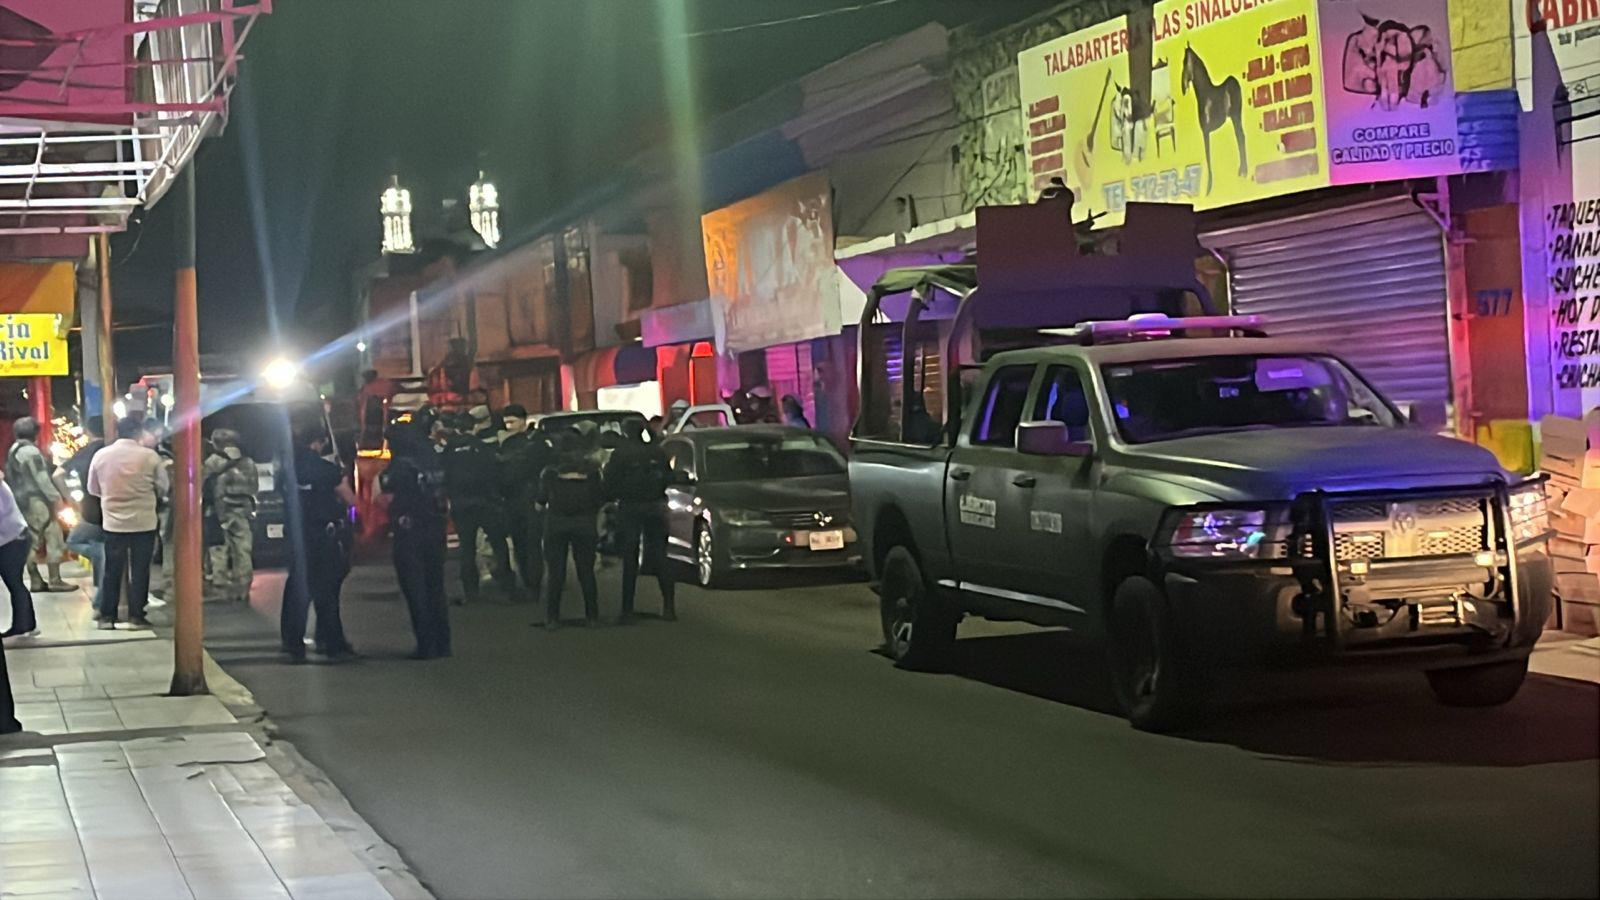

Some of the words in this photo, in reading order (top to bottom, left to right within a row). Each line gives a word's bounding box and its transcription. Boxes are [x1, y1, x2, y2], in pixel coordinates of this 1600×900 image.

[1152, 9, 1181, 41] LAS
[1353, 123, 1430, 143] COMPARE
[1332, 145, 1390, 164] CALIDAD
[1391, 144, 1403, 160] Y
[1405, 139, 1454, 160] PRECIO
[1557, 296, 1588, 325] HOT
